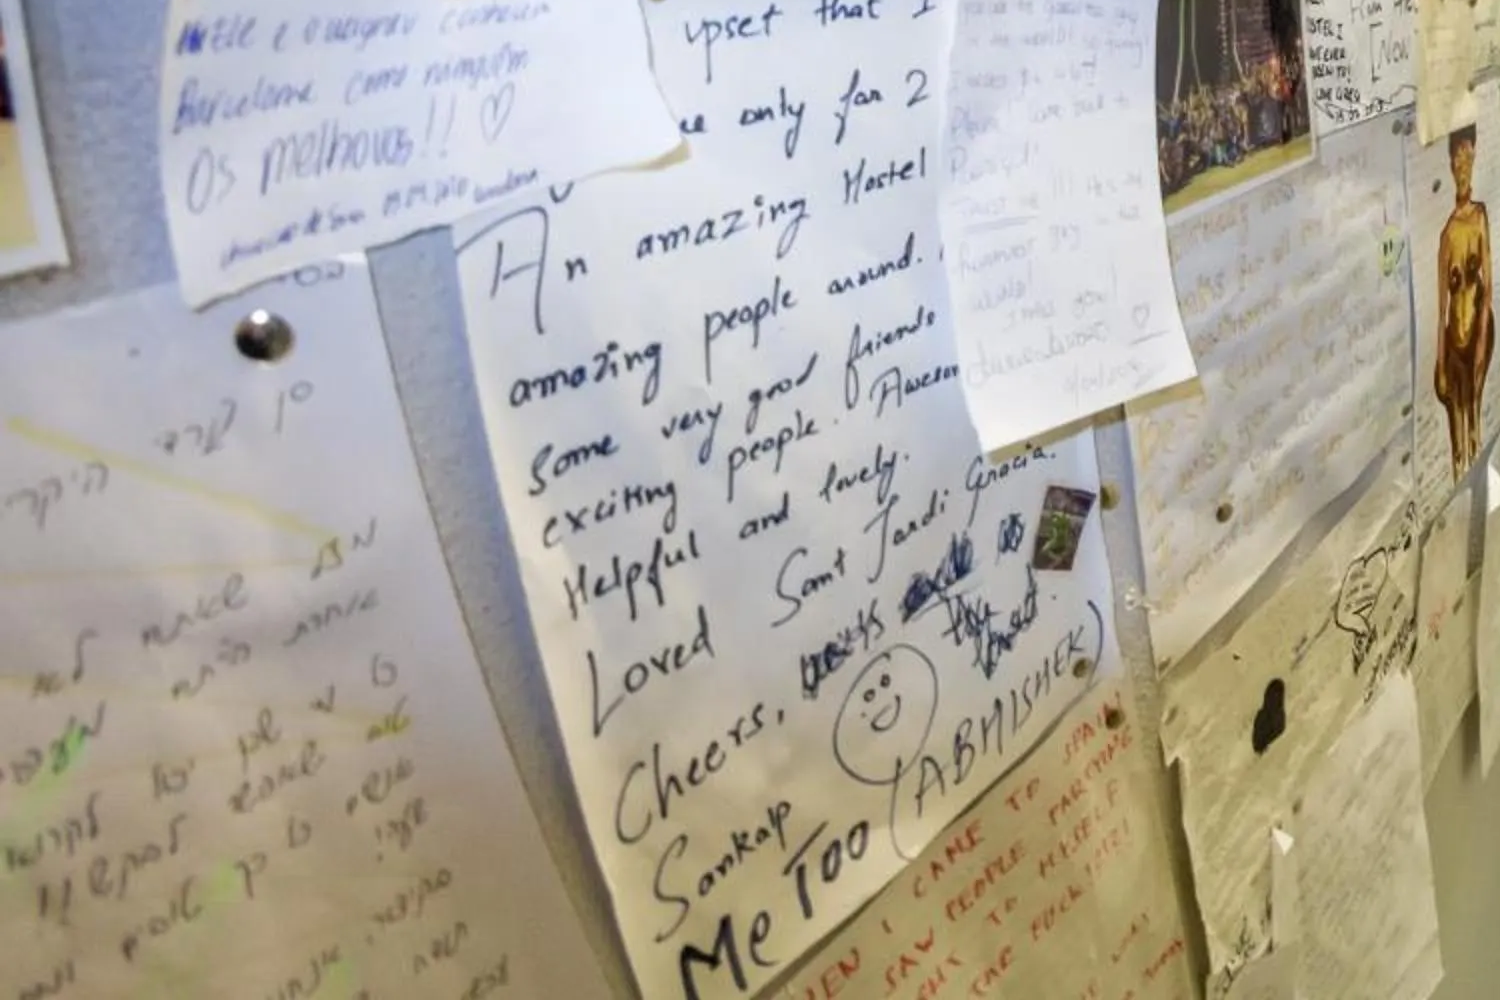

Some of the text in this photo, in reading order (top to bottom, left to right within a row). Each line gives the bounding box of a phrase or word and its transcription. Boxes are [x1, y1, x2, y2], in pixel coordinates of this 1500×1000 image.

[740, 87, 807, 158] only
[833, 68, 883, 145] for
[904, 67, 930, 107] 2
[636, 195, 810, 259] amazing
[843, 146, 928, 205] Hostel
[508, 340, 663, 408] amazing
[703, 275, 798, 385] people
[528, 434, 620, 498] Some
[662, 400, 723, 465] very
[845, 310, 938, 411] friends
[542, 478, 678, 550] exciting
[563, 531, 700, 622] Helpful
[738, 491, 790, 541] and
[586, 602, 716, 738] Loved
[771, 547, 848, 630] Sant
[615, 702, 785, 845] Cheers,
[912, 819, 987, 899] CAME
[1004, 776, 1042, 813] TO
[885, 925, 935, 992] SAW
[944, 839, 1029, 923] PEOPLE
